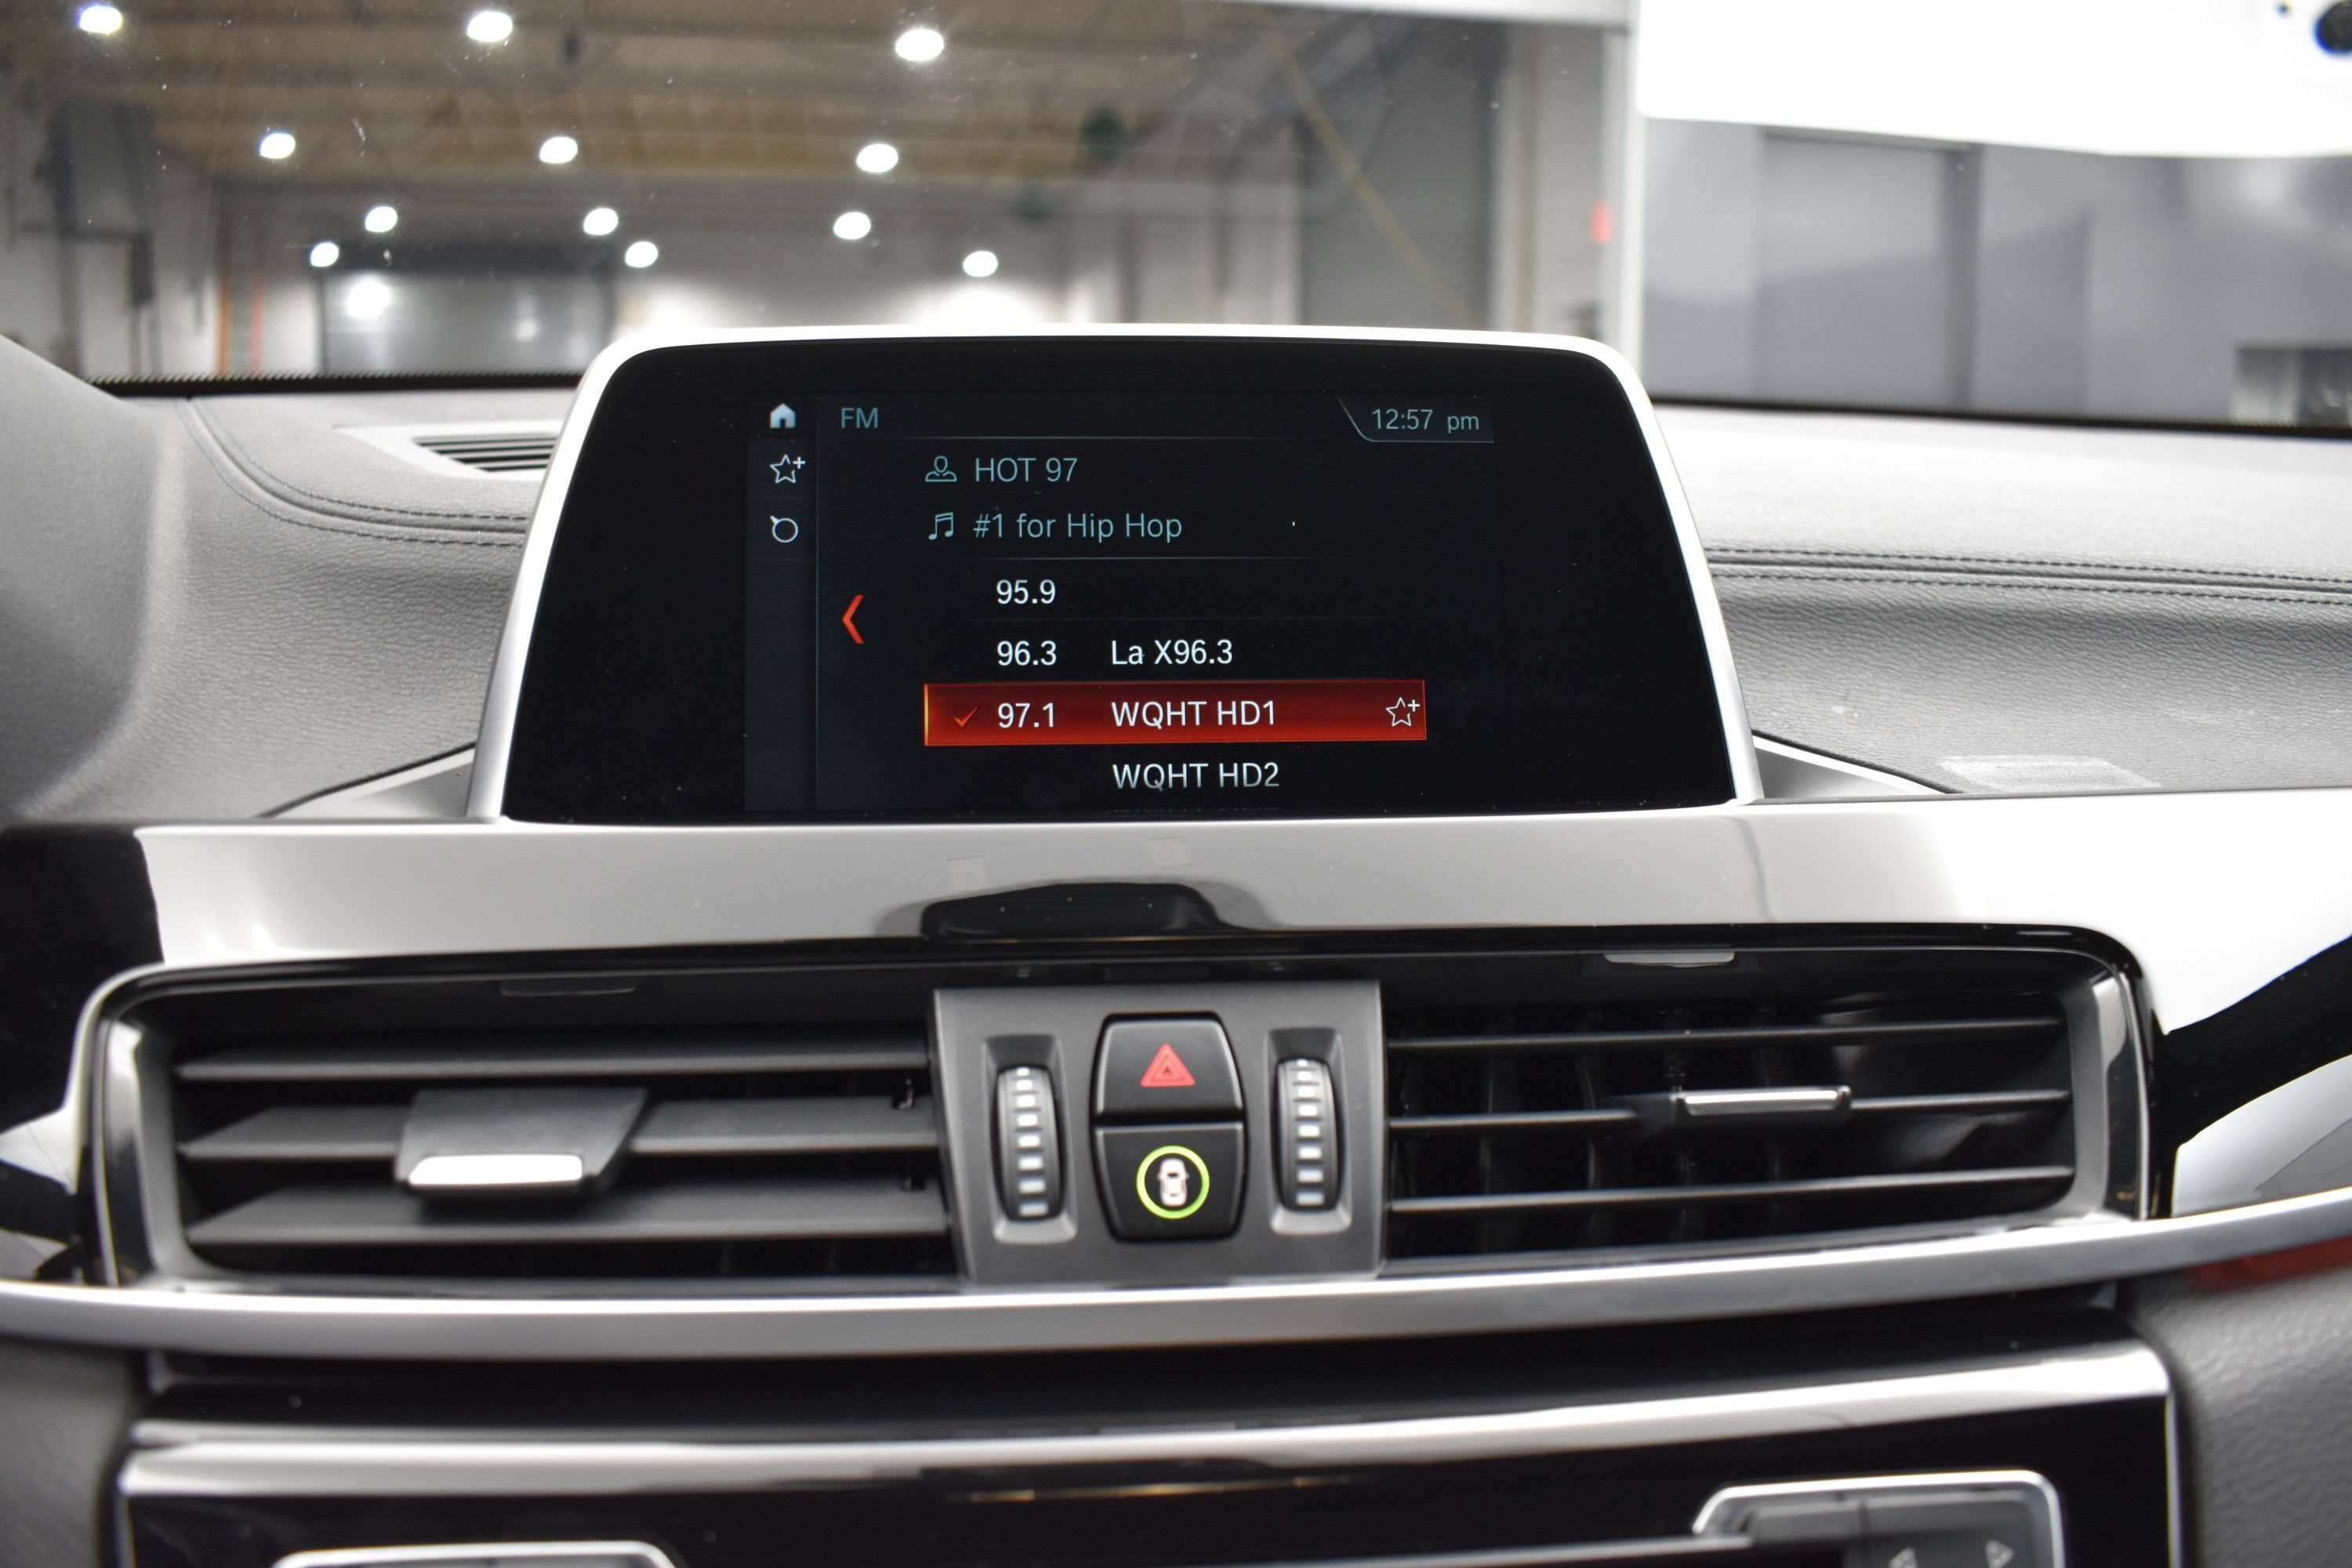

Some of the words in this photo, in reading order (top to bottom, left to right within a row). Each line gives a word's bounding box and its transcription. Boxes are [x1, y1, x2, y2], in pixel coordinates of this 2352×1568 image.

[841, 408, 878, 428] FM
[1373, 409, 1432, 430] 12:57
[1447, 416, 1479, 434] pm
[976, 458, 1036, 482] HOT
[1046, 458, 1077, 481] 97
[974, 514, 1002, 537] #1
[1017, 514, 1056, 538] for
[1068, 514, 1113, 543] Hip
[1126, 513, 1181, 543] Hop
[996, 579, 1055, 604] 95.9
[997, 641, 1056, 666] 96.3
[1112, 641, 1144, 665] La
[1155, 639, 1232, 664] X96.3
[998, 702, 1053, 728] 97.1
[1112, 702, 1207, 729] WQHT
[1218, 700, 1273, 725] HD1
[1112, 764, 1208, 790] WQHT
[1219, 762, 1279, 787] HD2
